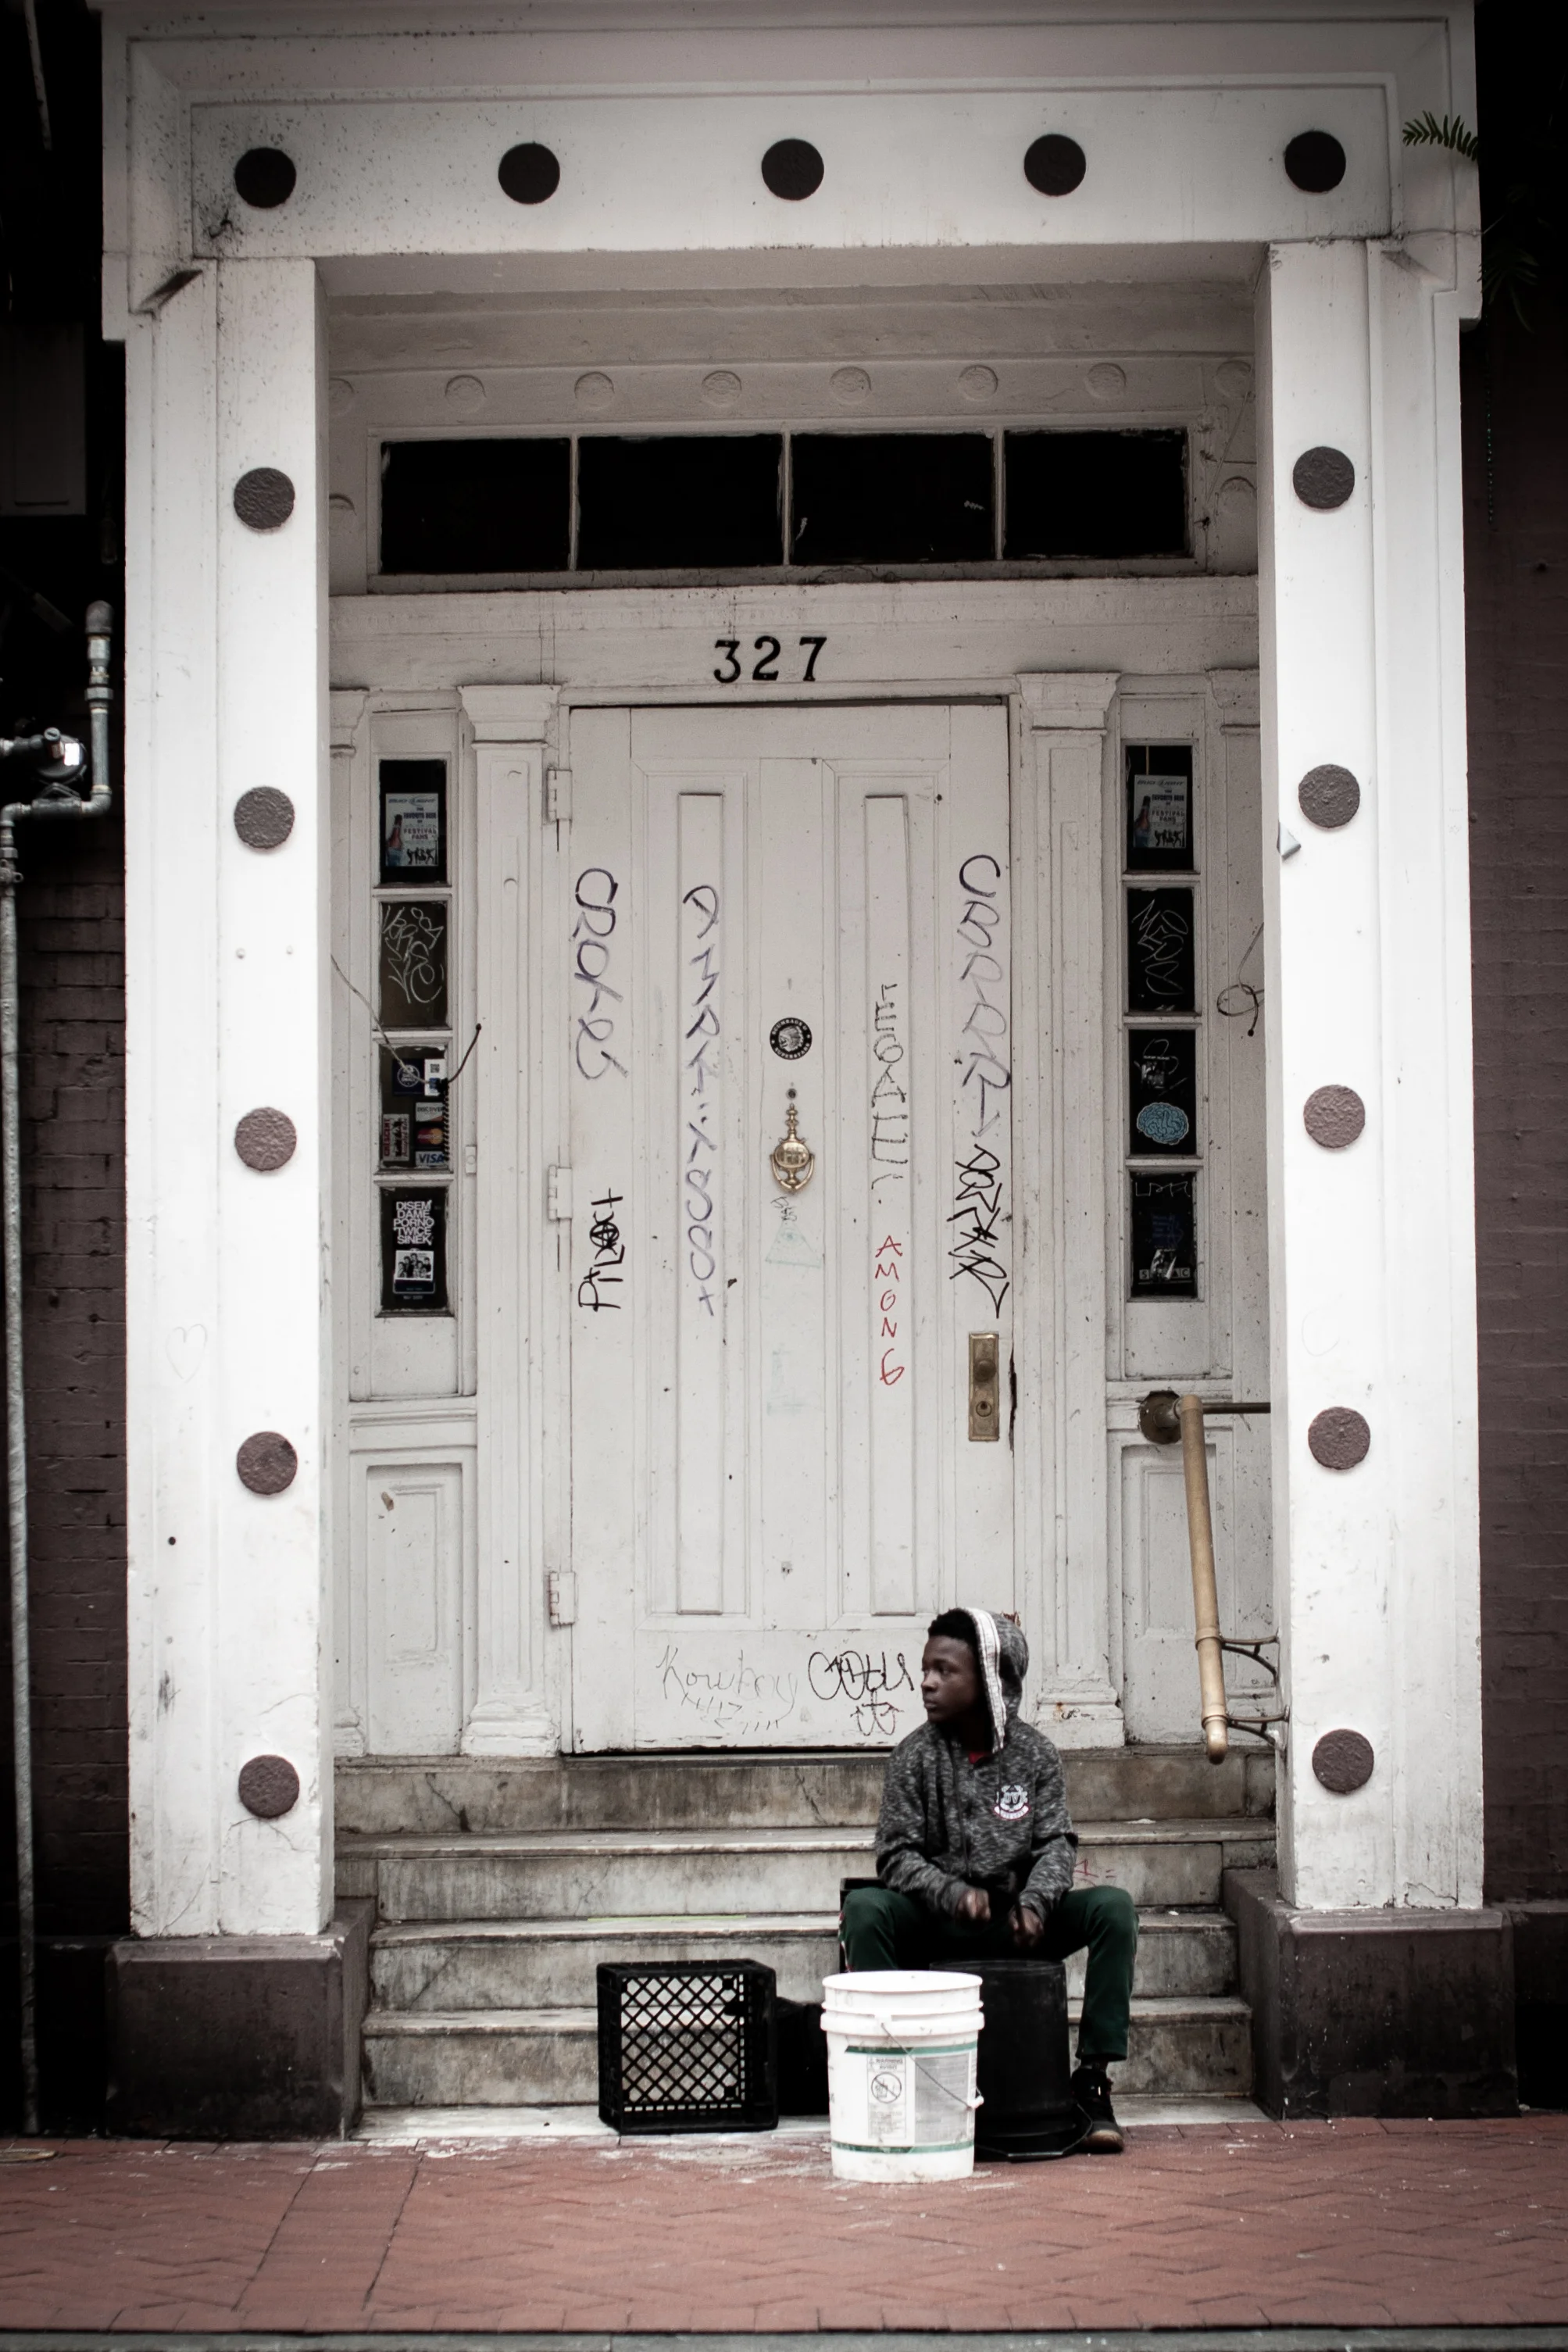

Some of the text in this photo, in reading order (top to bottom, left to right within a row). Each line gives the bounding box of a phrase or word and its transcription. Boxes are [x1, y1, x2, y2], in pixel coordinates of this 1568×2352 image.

[715, 637, 827, 684] 327
[419, 1153, 444, 1163] VISA
[397, 1210, 430, 1219] DAME
[393, 1218, 434, 1228] PORNO
